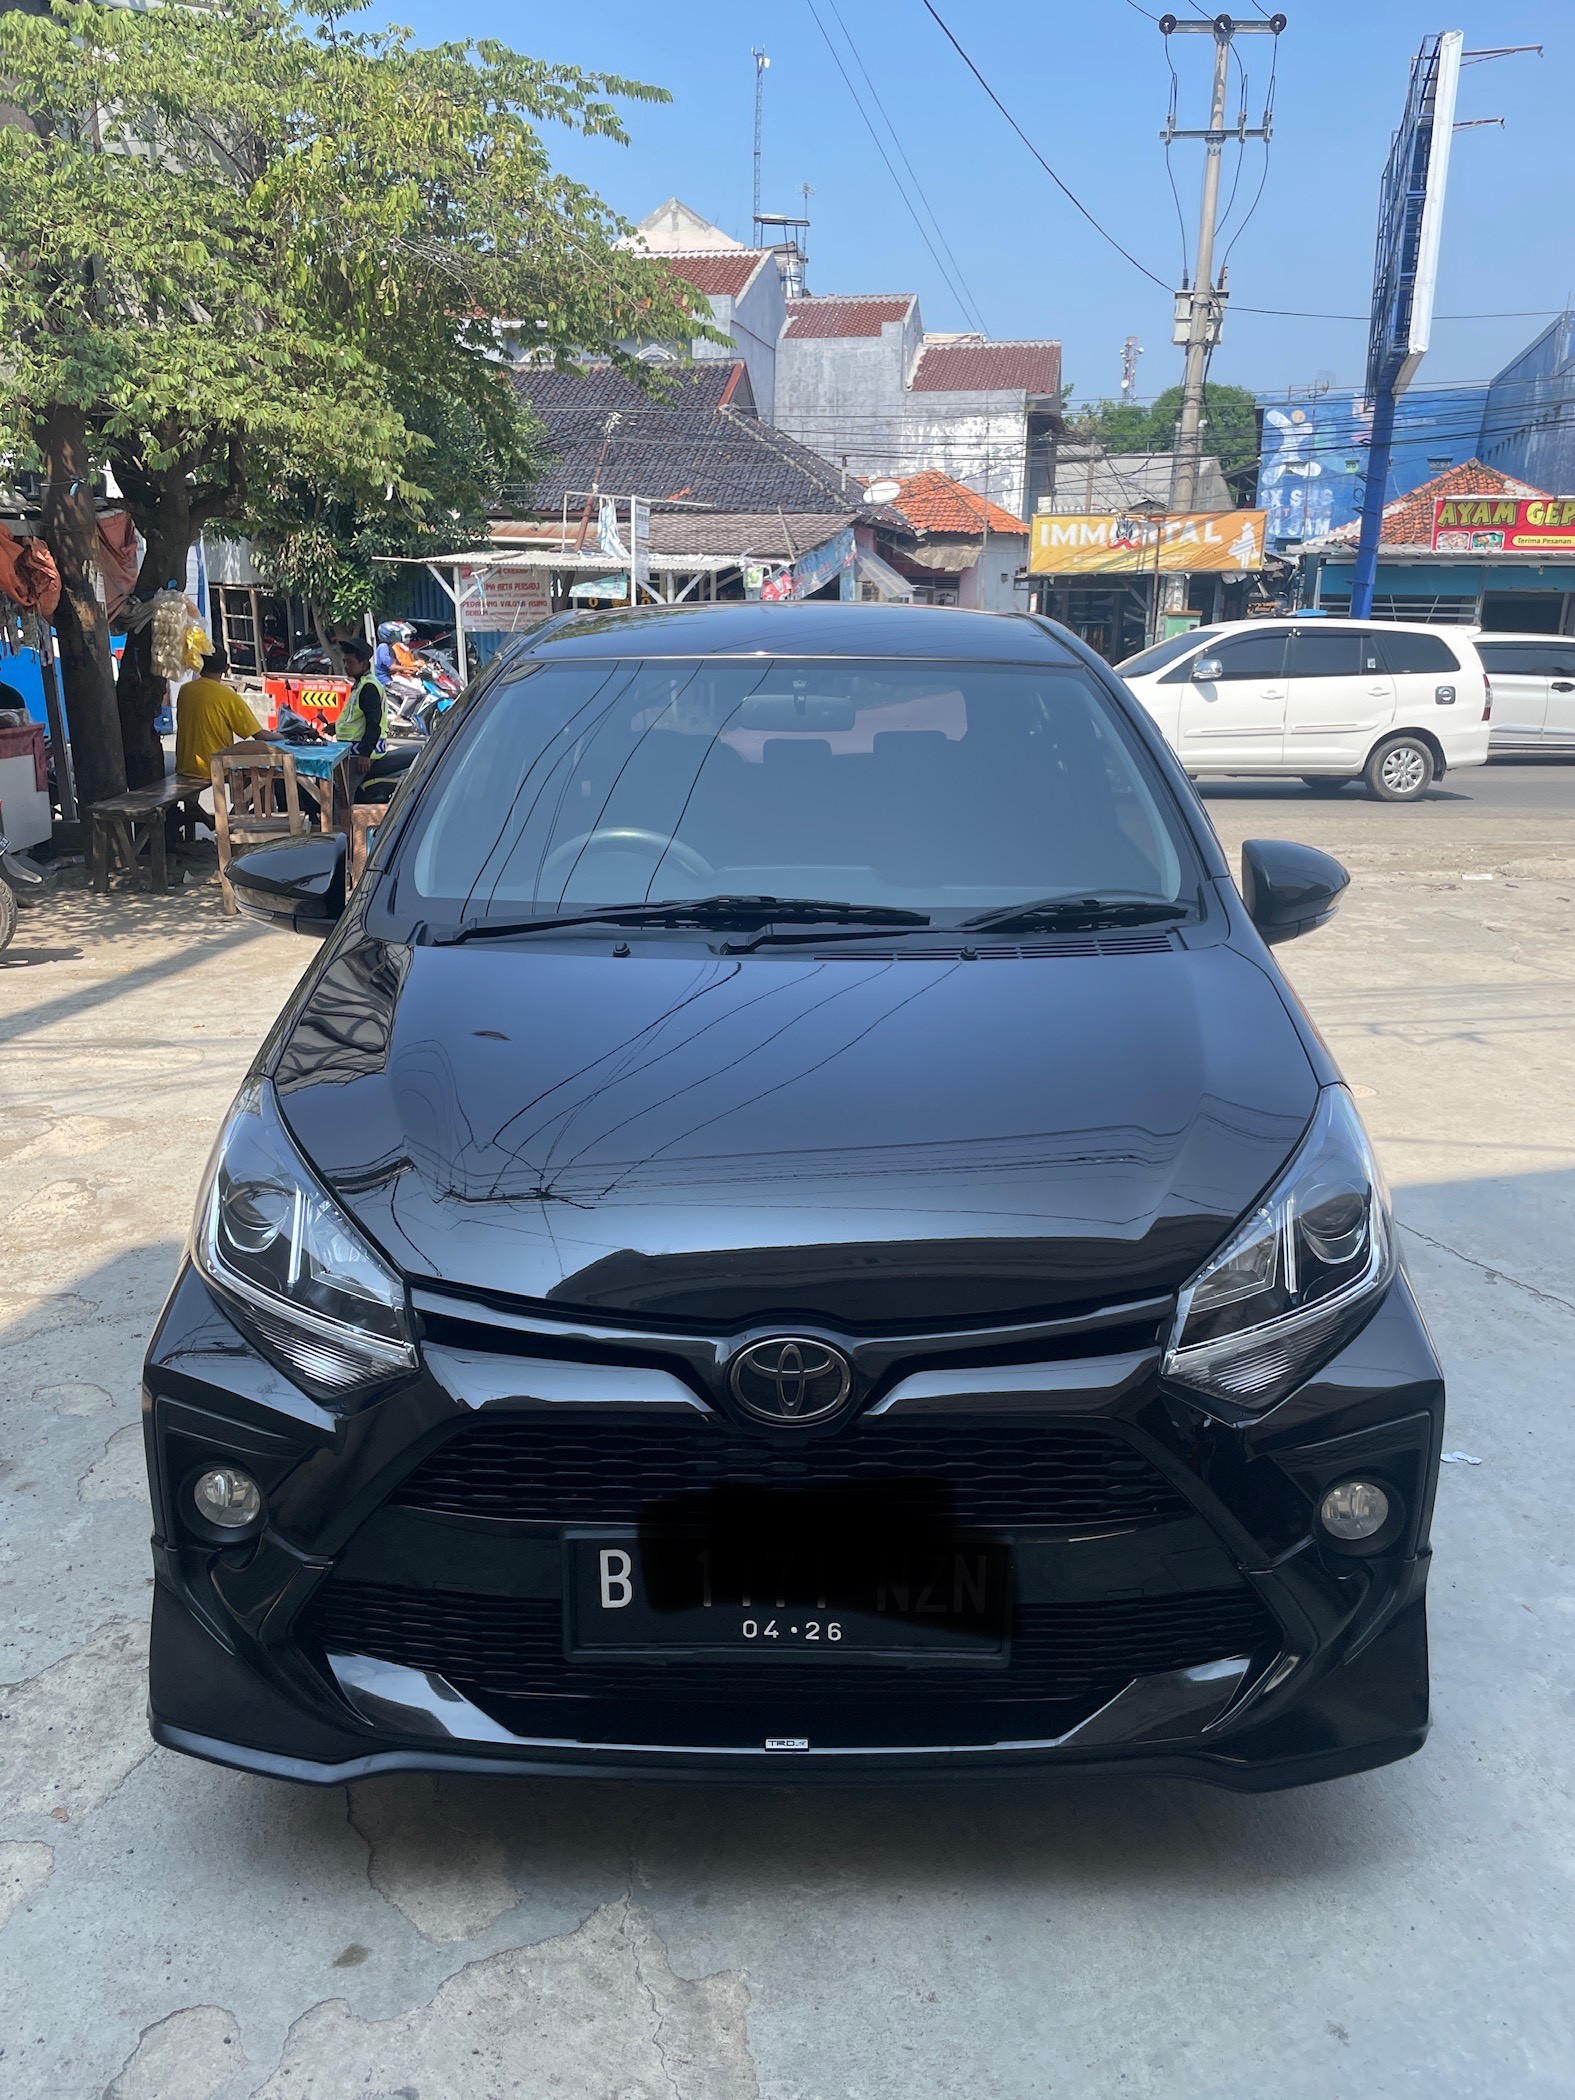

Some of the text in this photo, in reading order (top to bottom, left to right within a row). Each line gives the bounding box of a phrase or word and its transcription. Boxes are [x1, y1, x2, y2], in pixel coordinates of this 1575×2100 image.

[1437, 501, 1517, 527] AYAM
[1542, 538, 1572, 546] Pesanan
[599, 1549, 632, 1609] B
